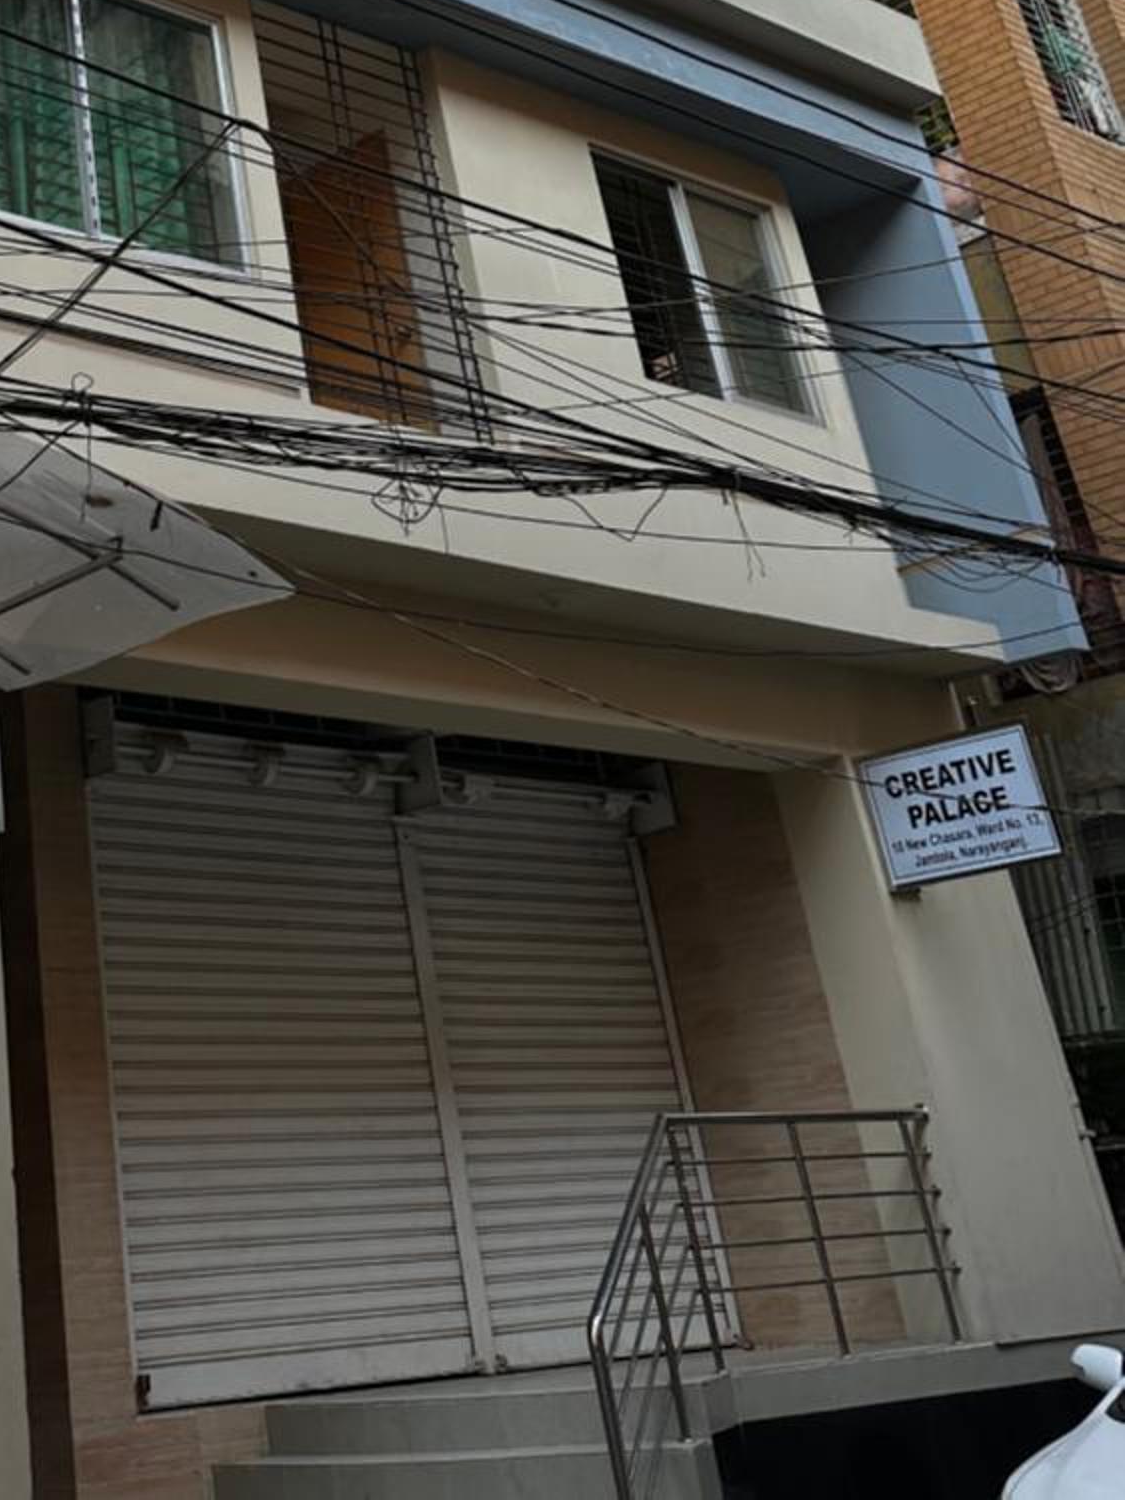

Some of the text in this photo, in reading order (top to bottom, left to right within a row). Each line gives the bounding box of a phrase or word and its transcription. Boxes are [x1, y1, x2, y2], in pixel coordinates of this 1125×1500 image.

[884, 749, 1016, 799] CREATIVE
[907, 786, 1010, 829] PALACE
[905, 838, 926, 850] New
[976, 820, 1003, 836] Ward
